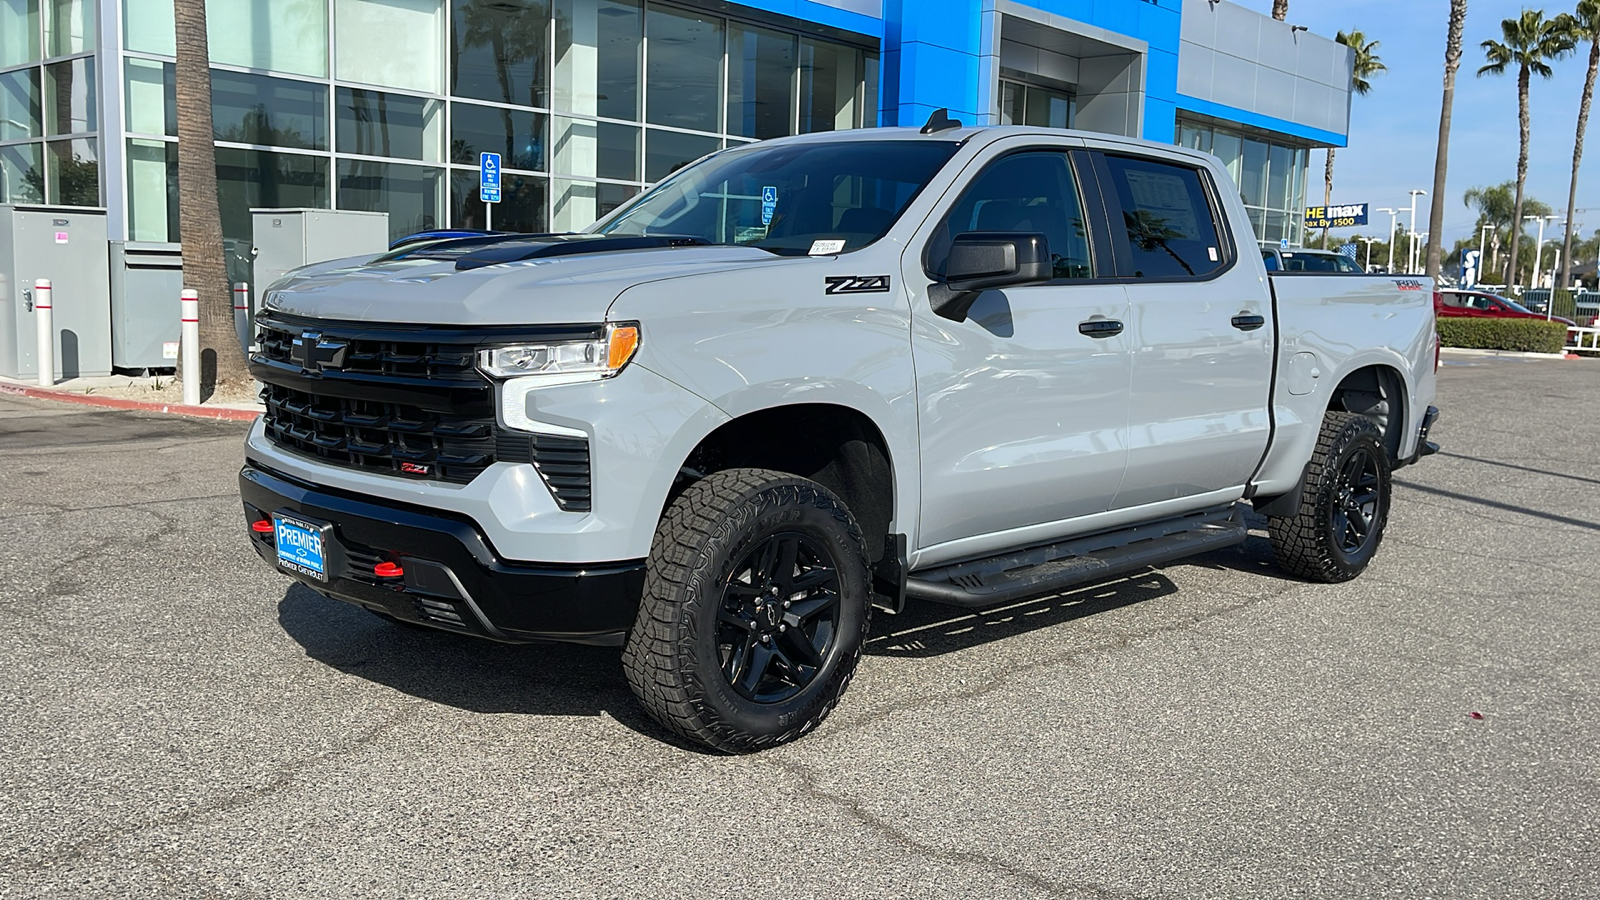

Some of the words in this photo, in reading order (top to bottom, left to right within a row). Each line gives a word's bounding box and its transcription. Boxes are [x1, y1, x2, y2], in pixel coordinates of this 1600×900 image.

[1327, 205, 1363, 218] max
[1319, 219, 1331, 228] By
[1333, 217, 1355, 226] $500
[825, 275, 890, 295] Z71
[278, 525, 323, 558] PREMIER
[278, 557, 297, 571] PREMIER
[297, 565, 323, 581] CHEVROLET
